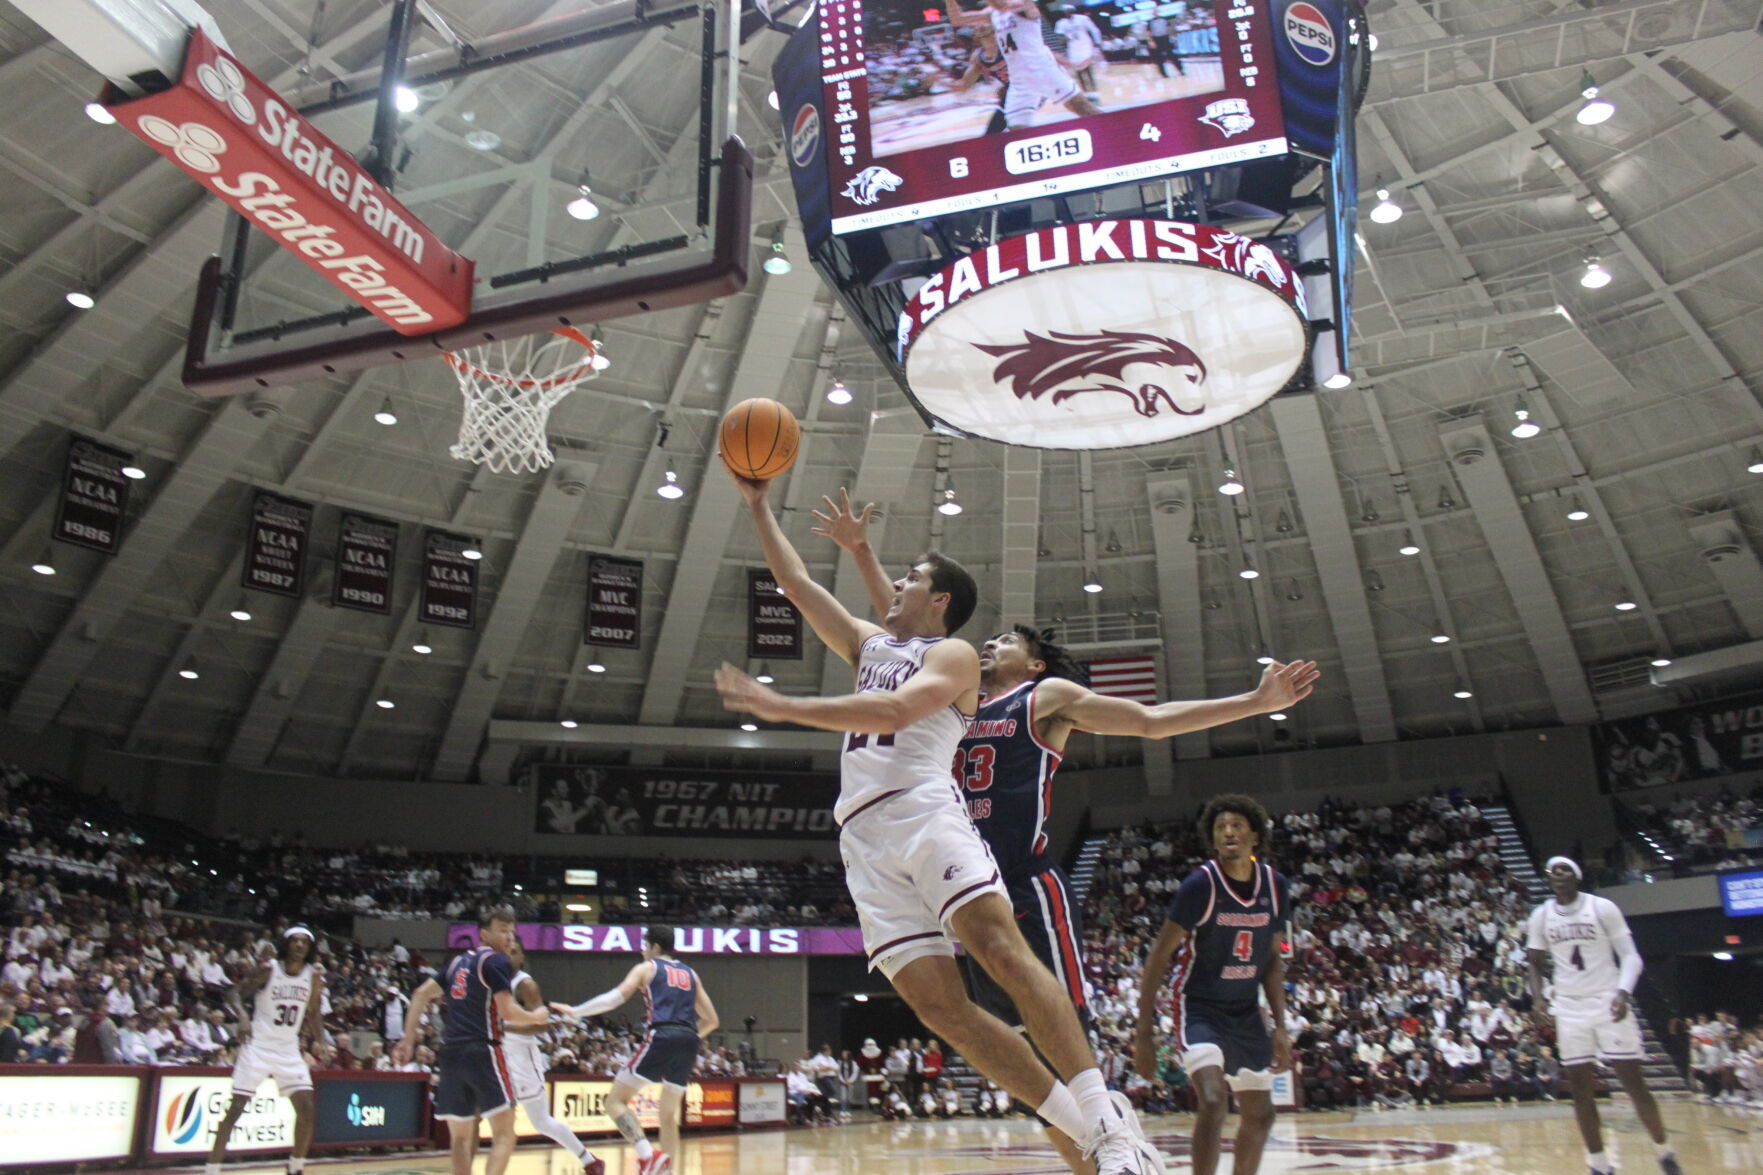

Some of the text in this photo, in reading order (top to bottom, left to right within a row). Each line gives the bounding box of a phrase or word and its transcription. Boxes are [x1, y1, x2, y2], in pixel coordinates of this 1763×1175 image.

[1287, 18, 1333, 49] PEPSI
[1205, 98, 1248, 117] USI
[1139, 123, 1162, 142] 4
[1016, 137, 1080, 164] 16:19
[1258, 144, 1267, 154] 2
[949, 157, 970, 179] 6
[919, 219, 1200, 323] SALUKIS
[71, 477, 118, 504] NCAA
[63, 520, 111, 544] 1986
[258, 528, 299, 551] NCAA
[345, 548, 386, 569] NCAA
[252, 568, 295, 588] 1987
[430, 565, 470, 584] NCAA
[342, 587, 385, 606] 1990
[600, 589, 629, 606] MVC
[428, 603, 468, 620] 1992
[760, 605, 792, 618] MVC
[590, 625, 635, 640] 2007
[756, 633, 793, 646] 2022
[643, 780, 781, 802] 1967 NIT
[562, 924, 799, 953] SAUKIS
[1231, 929, 1254, 962] 4
[1570, 944, 1586, 972] 4
[663, 964, 692, 992] 10
[273, 1004, 299, 1027] 30
[208, 1091, 276, 1114] Gden
[205, 1118, 285, 1144] Hrvest
